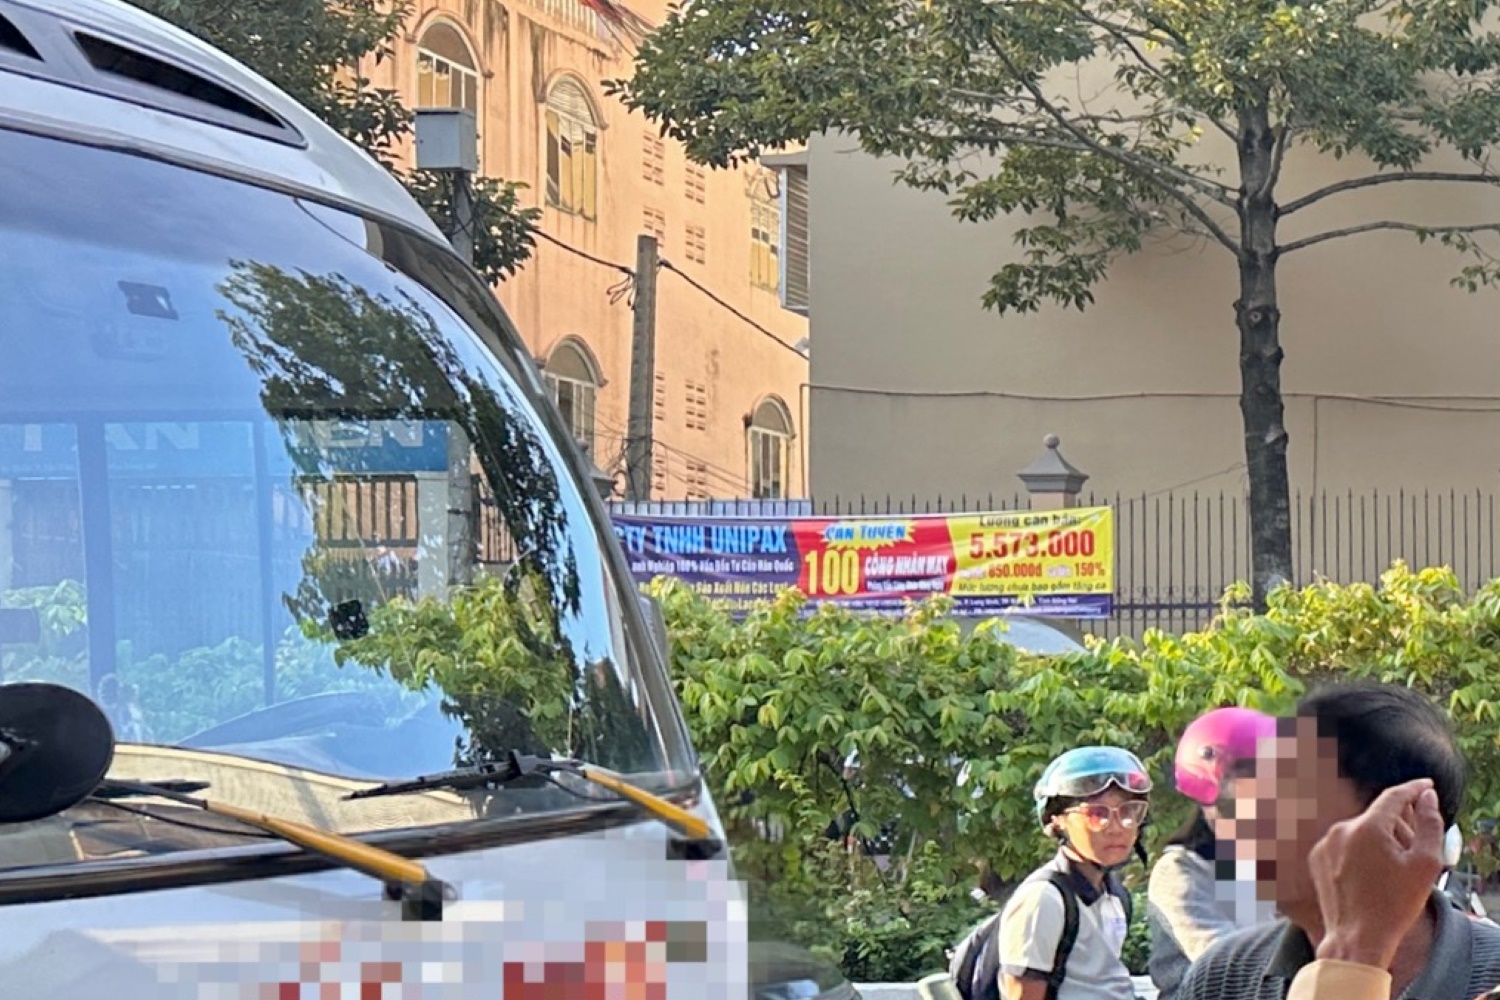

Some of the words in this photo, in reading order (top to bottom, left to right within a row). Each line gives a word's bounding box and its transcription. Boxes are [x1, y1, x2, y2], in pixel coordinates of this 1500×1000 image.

[652, 525, 705, 553] TNHH
[711, 525, 787, 553] UNIPAX
[970, 529, 1095, 559] 5.573.000
[804, 549, 860, 595] 100
[1074, 562, 1105, 577] 150%
